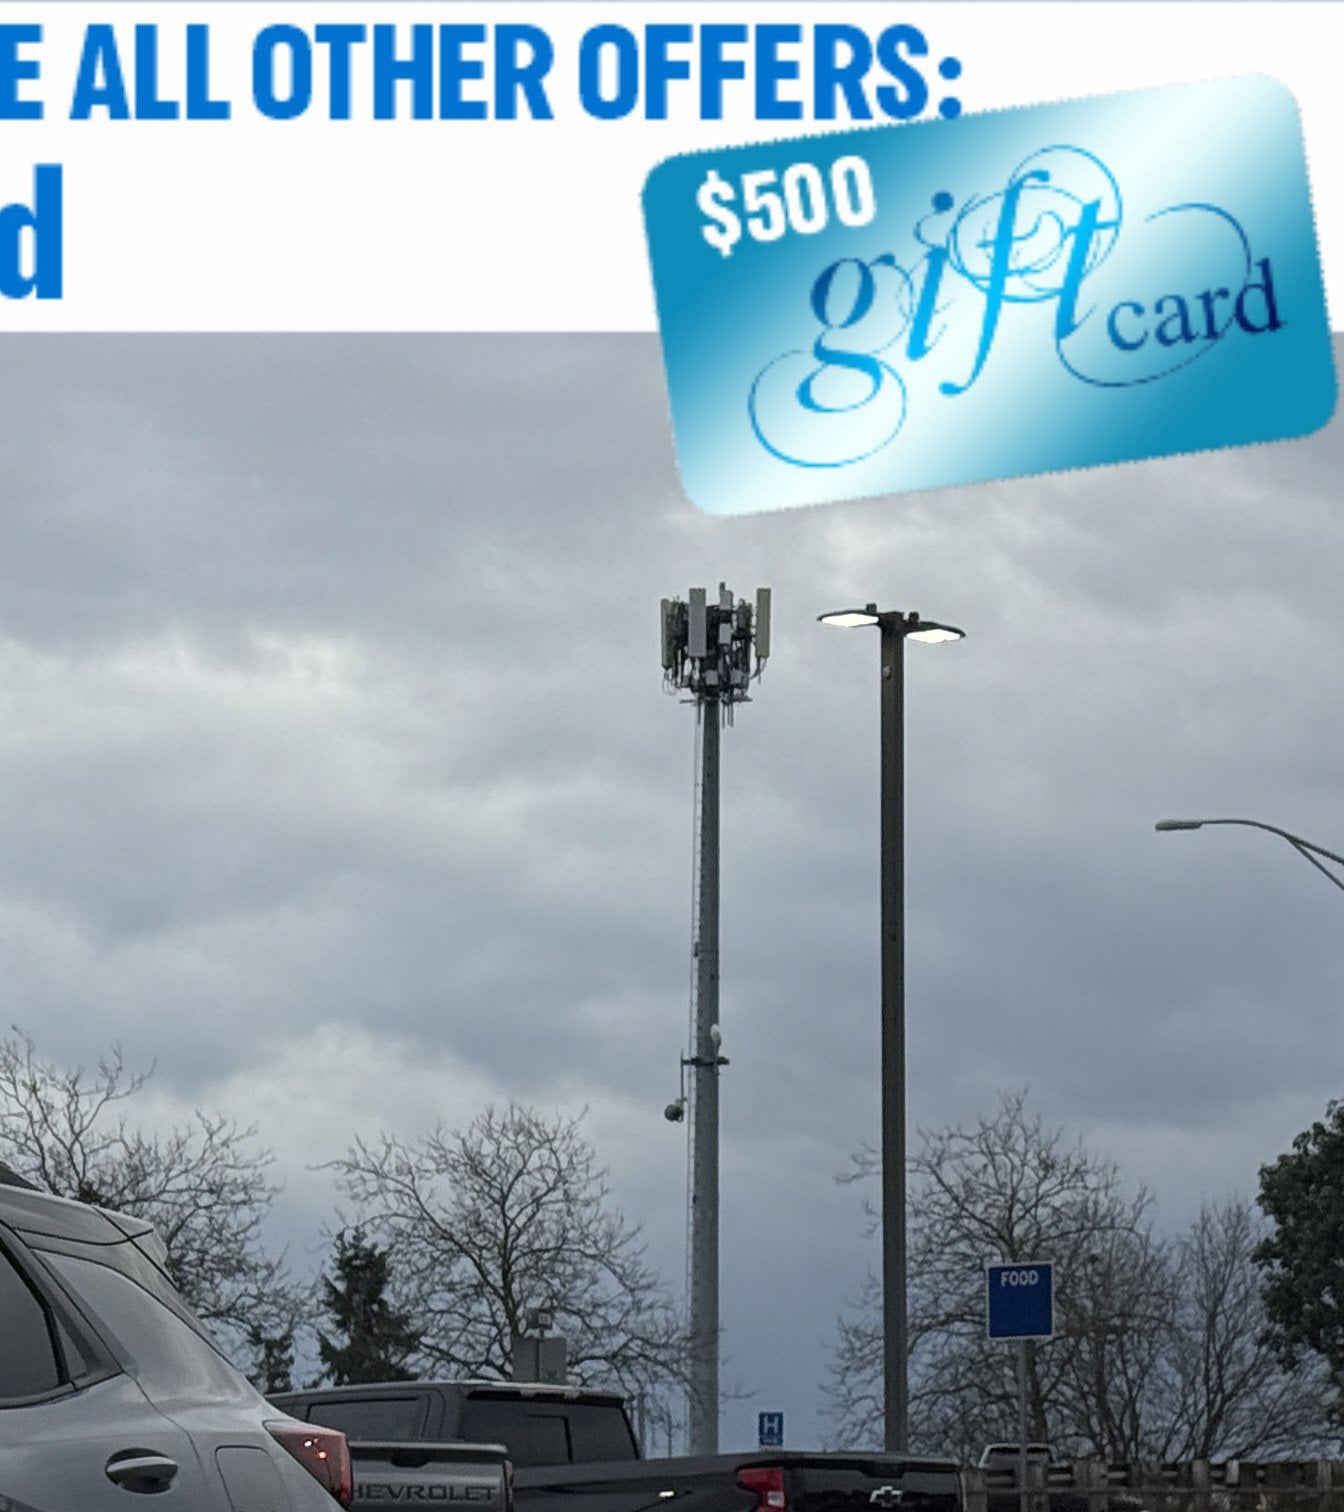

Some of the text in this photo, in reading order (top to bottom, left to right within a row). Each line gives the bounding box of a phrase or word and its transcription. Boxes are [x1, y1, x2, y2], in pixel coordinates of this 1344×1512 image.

[1001, 1269, 1039, 1287] FOOD
[763, 1415, 779, 1434] H
[353, 1482, 498, 1501] HEVROLET
